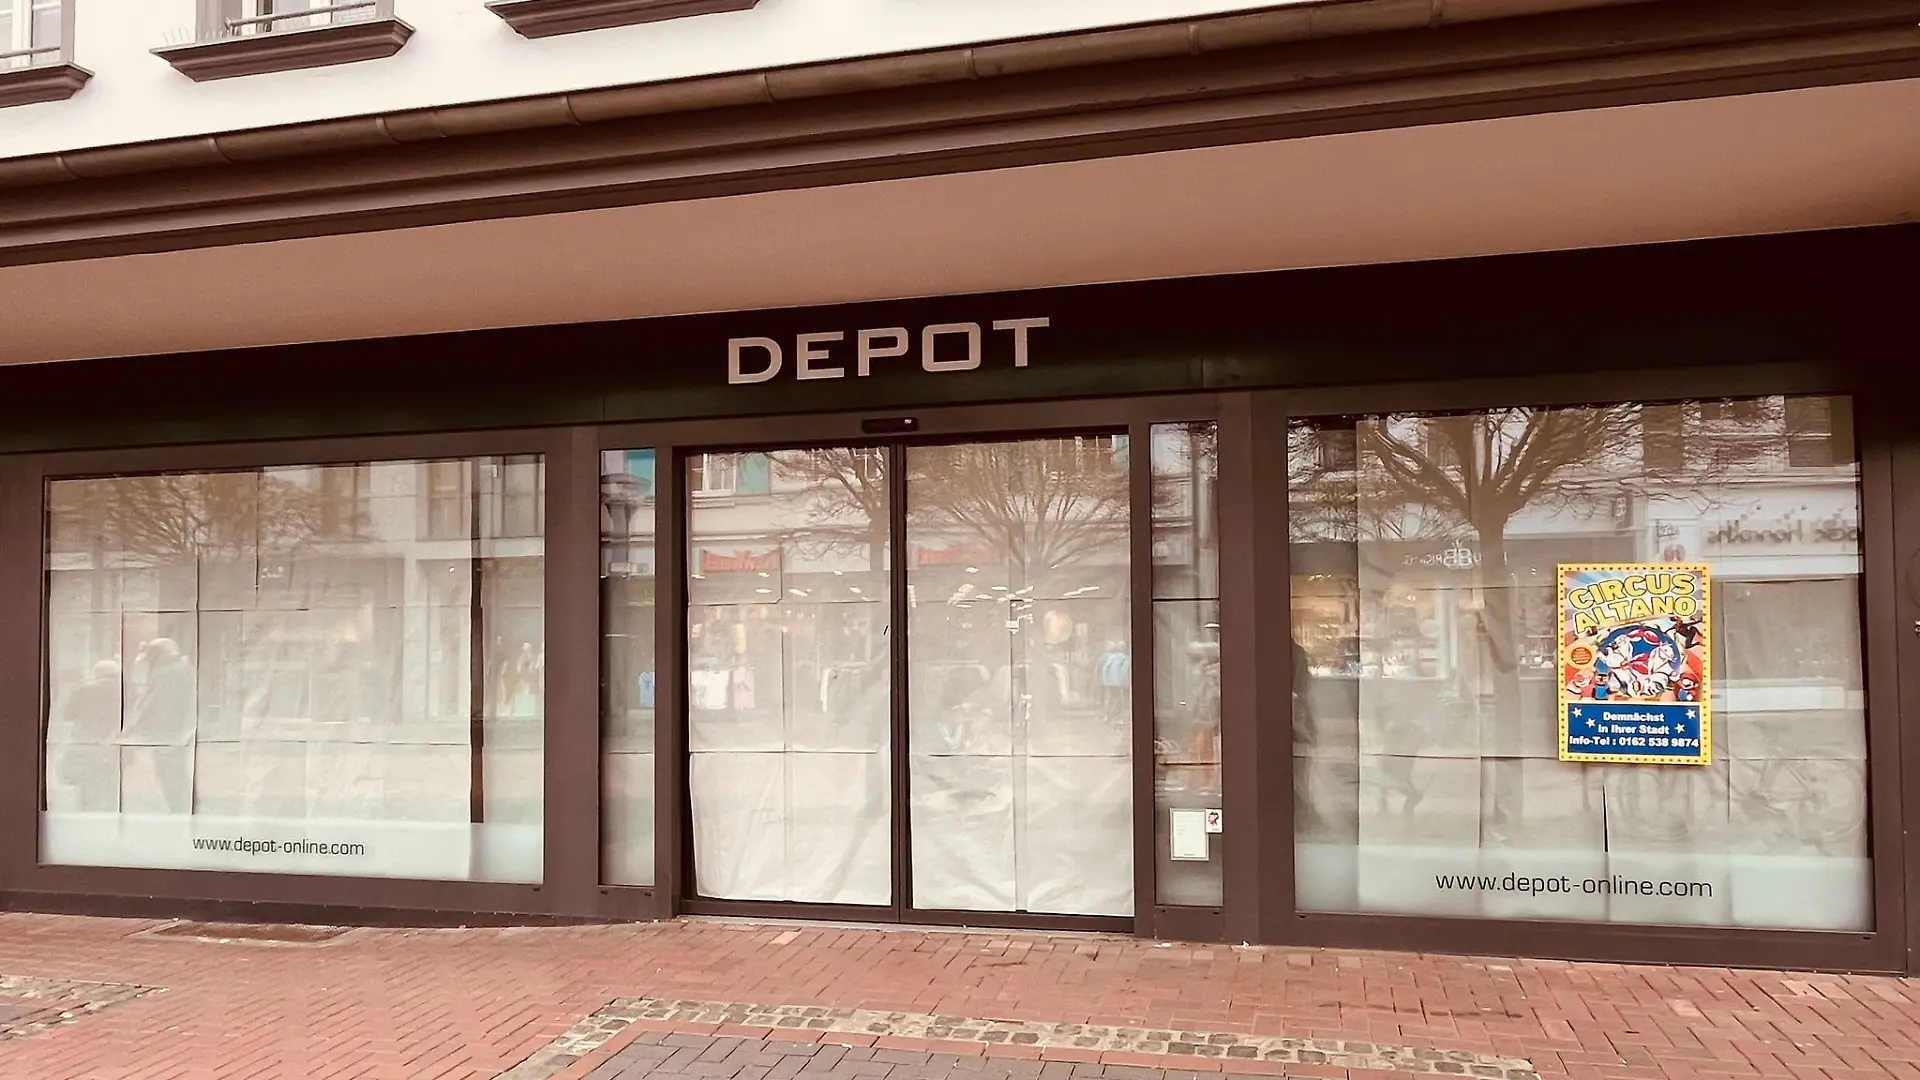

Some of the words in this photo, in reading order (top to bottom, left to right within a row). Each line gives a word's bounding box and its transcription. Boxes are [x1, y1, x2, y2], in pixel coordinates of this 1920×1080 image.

[728, 317, 1050, 384] DEPOT
[1568, 573, 1695, 610] CIRCUS
[1574, 596, 1697, 634] ALTANO
[1603, 711, 1665, 722] Demnächst
[1611, 724, 1637, 734] Ihrer
[1639, 725, 1670, 735] Stadt
[1569, 735, 1610, 746] Info-Tel
[1619, 736, 1646, 747] 0162
[1648, 737, 1669, 747] 538
[1671, 738, 1700, 748] 9874
[192, 836, 365, 856] www.depot-online.com
[1435, 872, 1713, 898] www.depot-online.com
